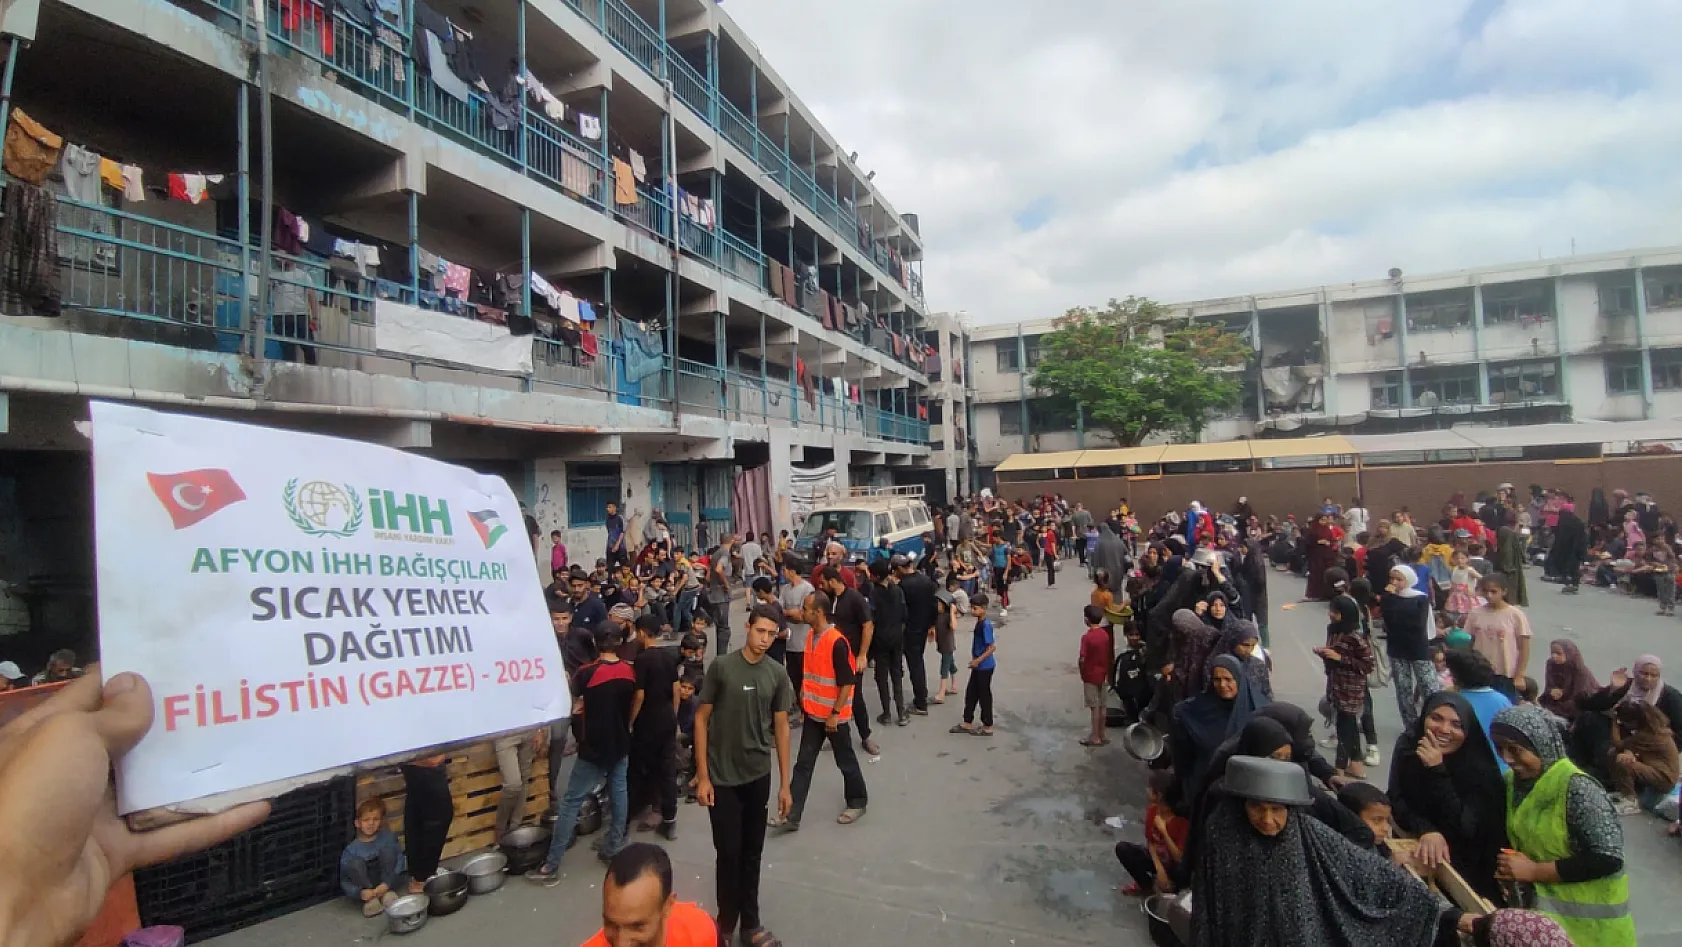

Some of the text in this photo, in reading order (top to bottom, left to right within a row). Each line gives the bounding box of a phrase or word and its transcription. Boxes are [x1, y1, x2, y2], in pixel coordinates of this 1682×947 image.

[191, 547, 508, 584] AFYON İHH BAĞIŞÇILARI
[250, 586, 489, 621] SICAK YEMEK
[303, 622, 474, 666] DAĞITIMI
[163, 671, 349, 732] FİLİSTİN
[358, 662, 475, 706] (GAZZE)
[495, 657, 546, 684] 2025
